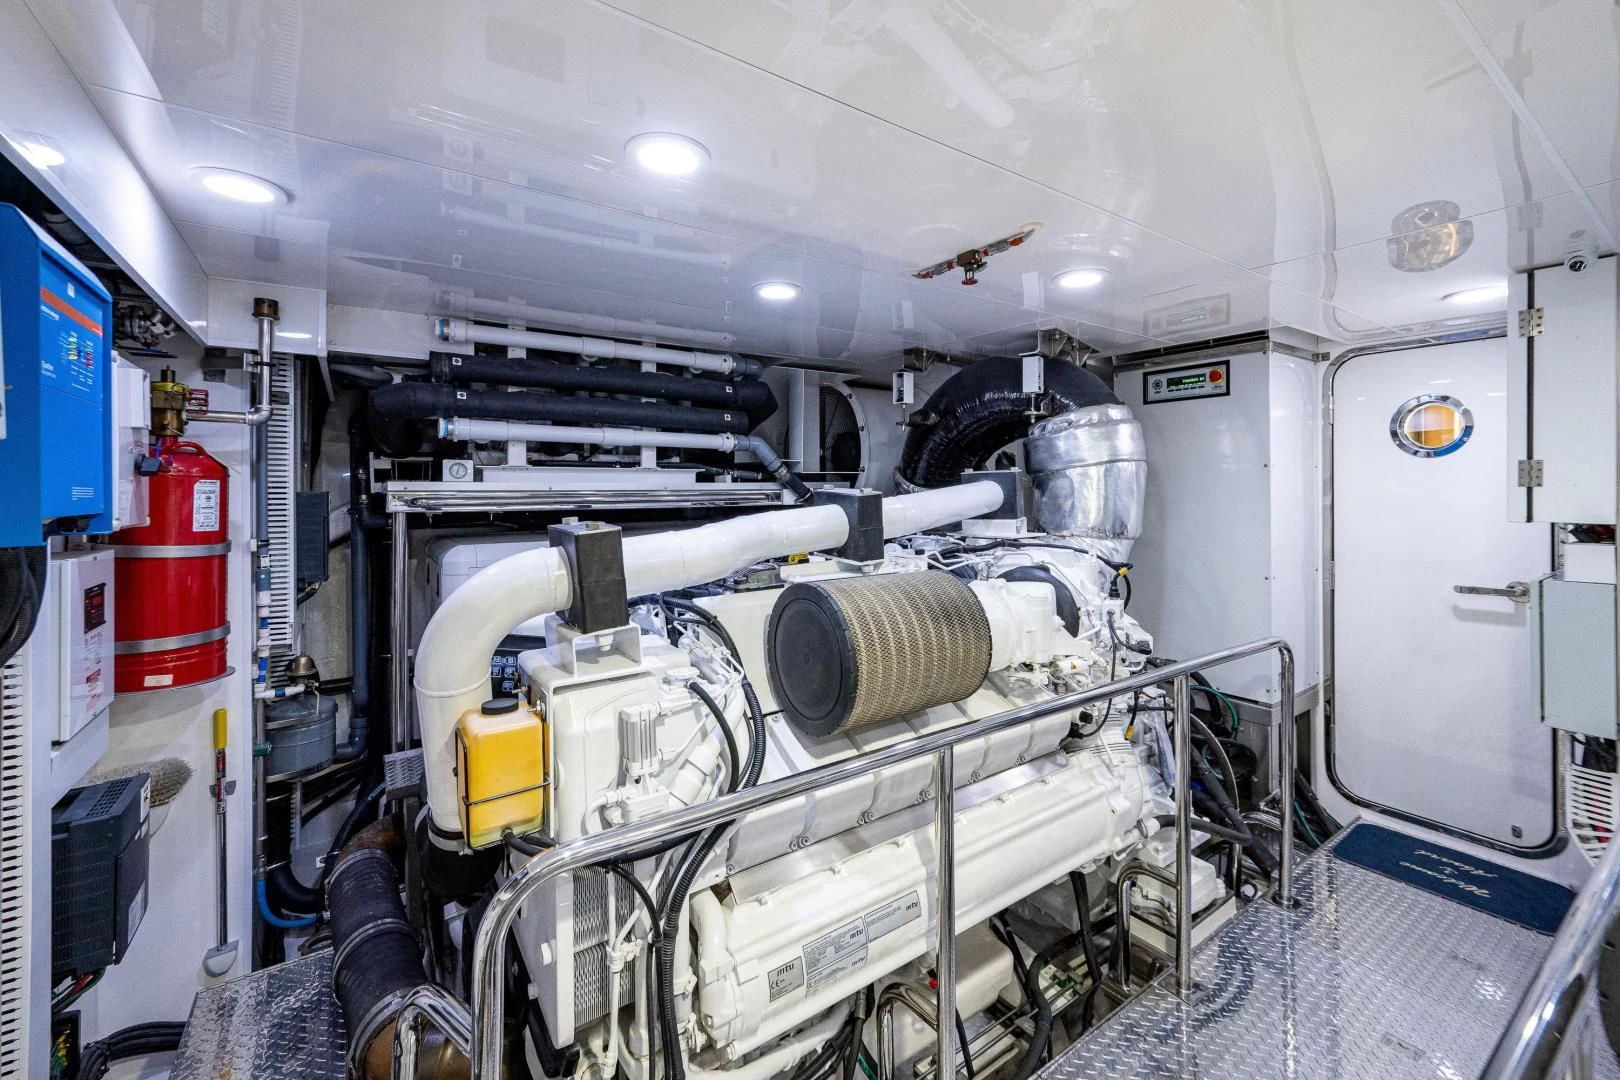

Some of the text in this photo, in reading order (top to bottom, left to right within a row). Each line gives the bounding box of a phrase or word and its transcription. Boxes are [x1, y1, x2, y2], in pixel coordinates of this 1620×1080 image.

[1399, 861, 1491, 897] Welcome
[905, 901, 919, 911] mtu
[849, 928, 864, 940] mtu
[777, 963, 794, 976] mtu
